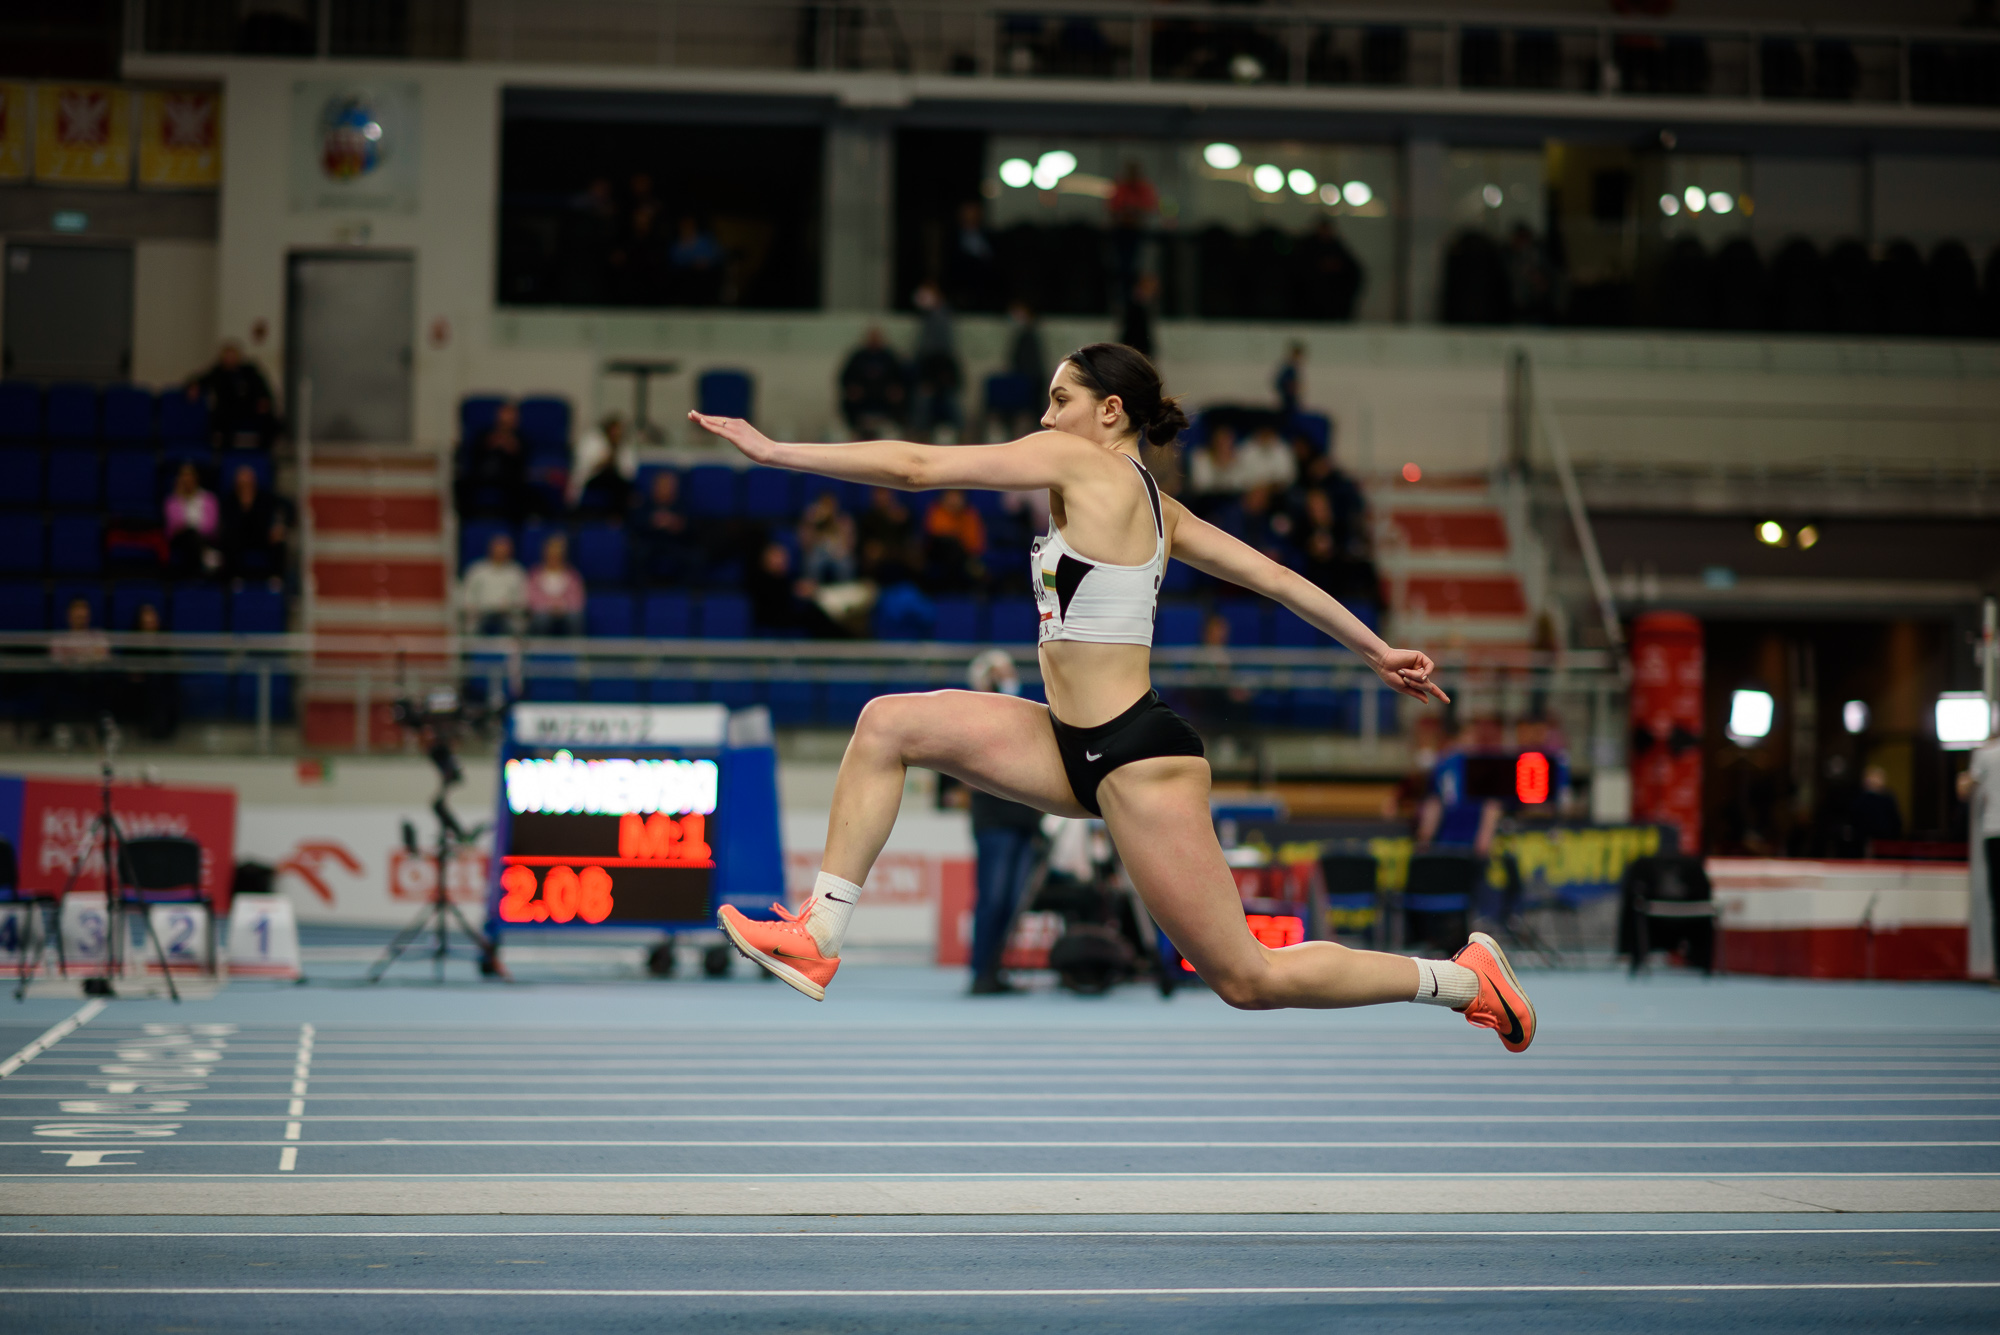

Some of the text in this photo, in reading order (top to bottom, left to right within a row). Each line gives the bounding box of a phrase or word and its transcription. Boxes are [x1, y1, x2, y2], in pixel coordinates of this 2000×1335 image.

[1516, 752, 1549, 804] 0
[500, 865, 613, 923] 2.08
[79, 911, 106, 954] 3
[168, 913, 196, 955] 2
[253, 914, 270, 958] 1
